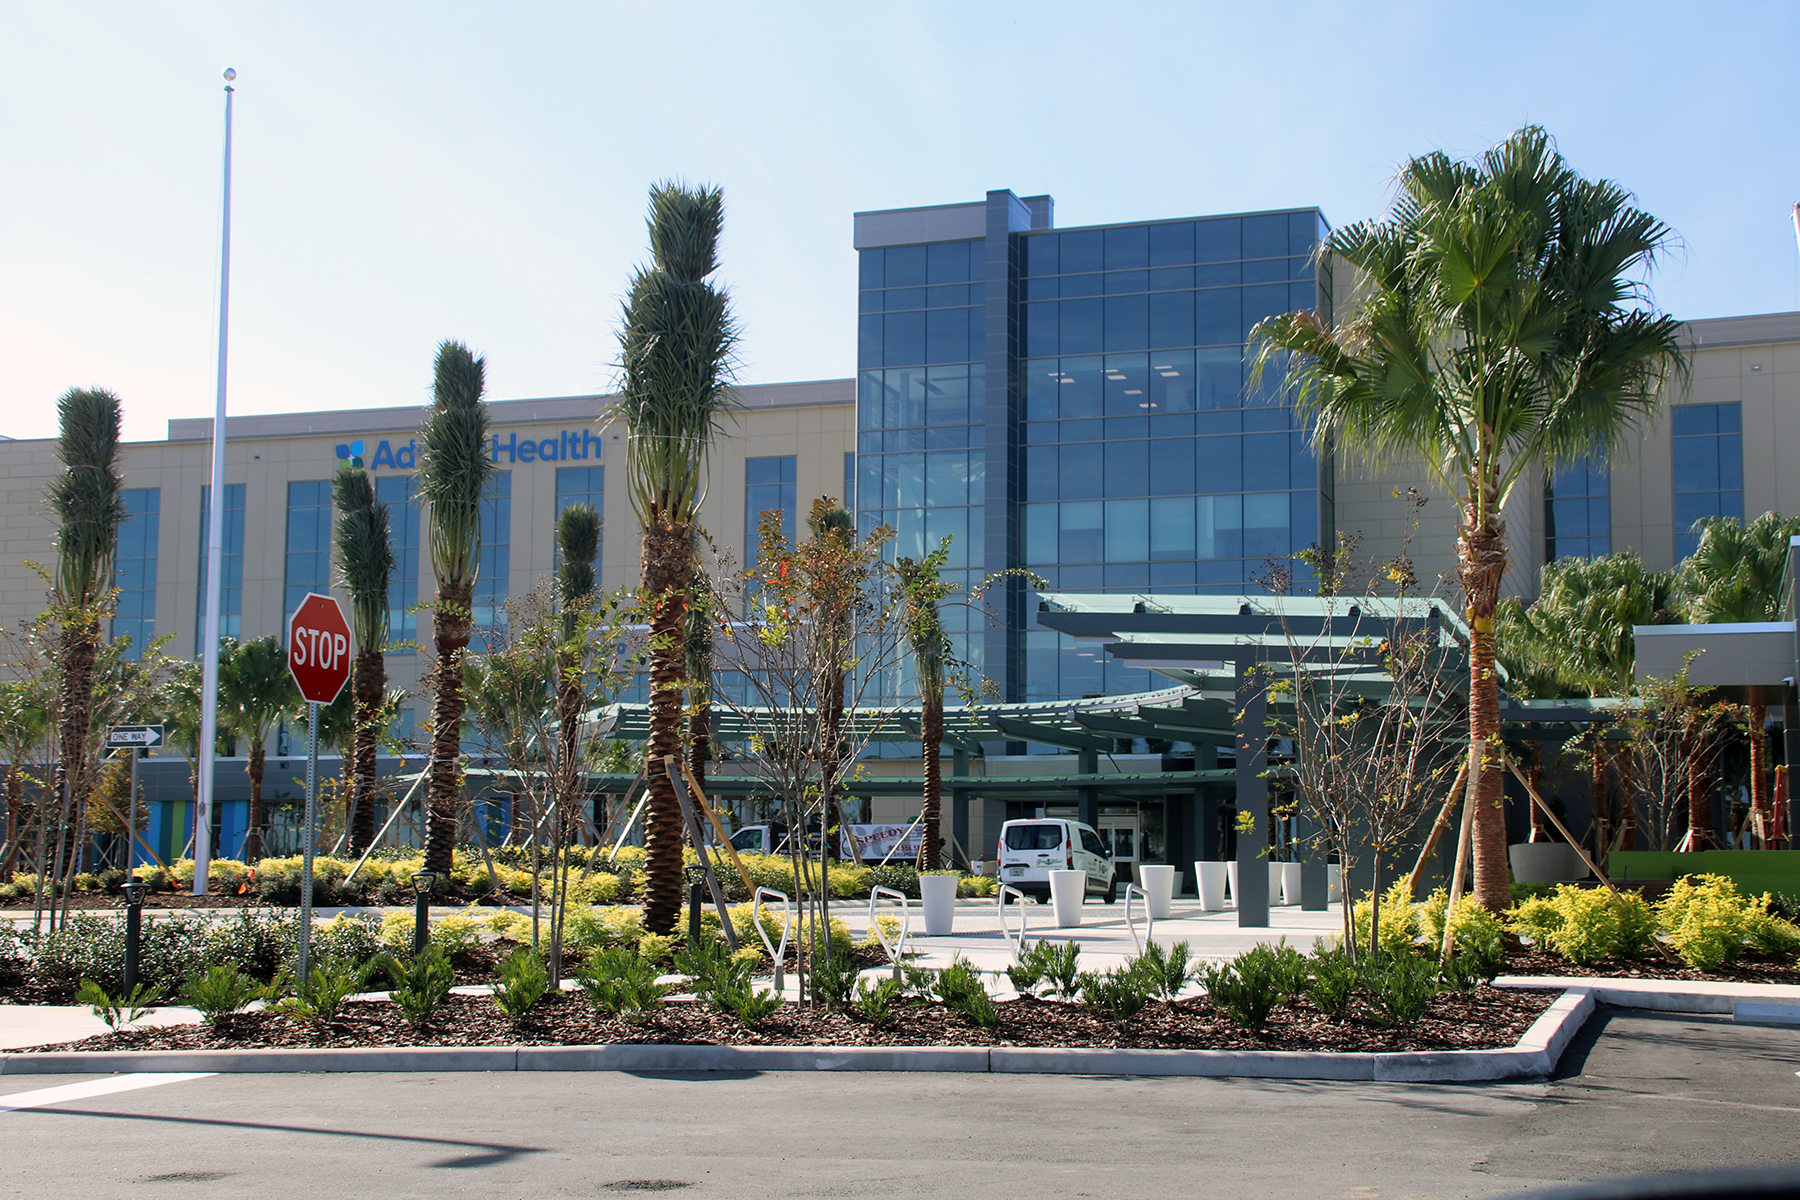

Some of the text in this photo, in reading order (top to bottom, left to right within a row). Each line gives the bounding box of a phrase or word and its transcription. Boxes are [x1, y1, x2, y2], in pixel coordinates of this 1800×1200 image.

[371, 429, 602, 470] AdHealth
[294, 626, 347, 671] STOP
[112, 732, 147, 741] ONE WAY
[856, 826, 904, 845] SPEEDY
